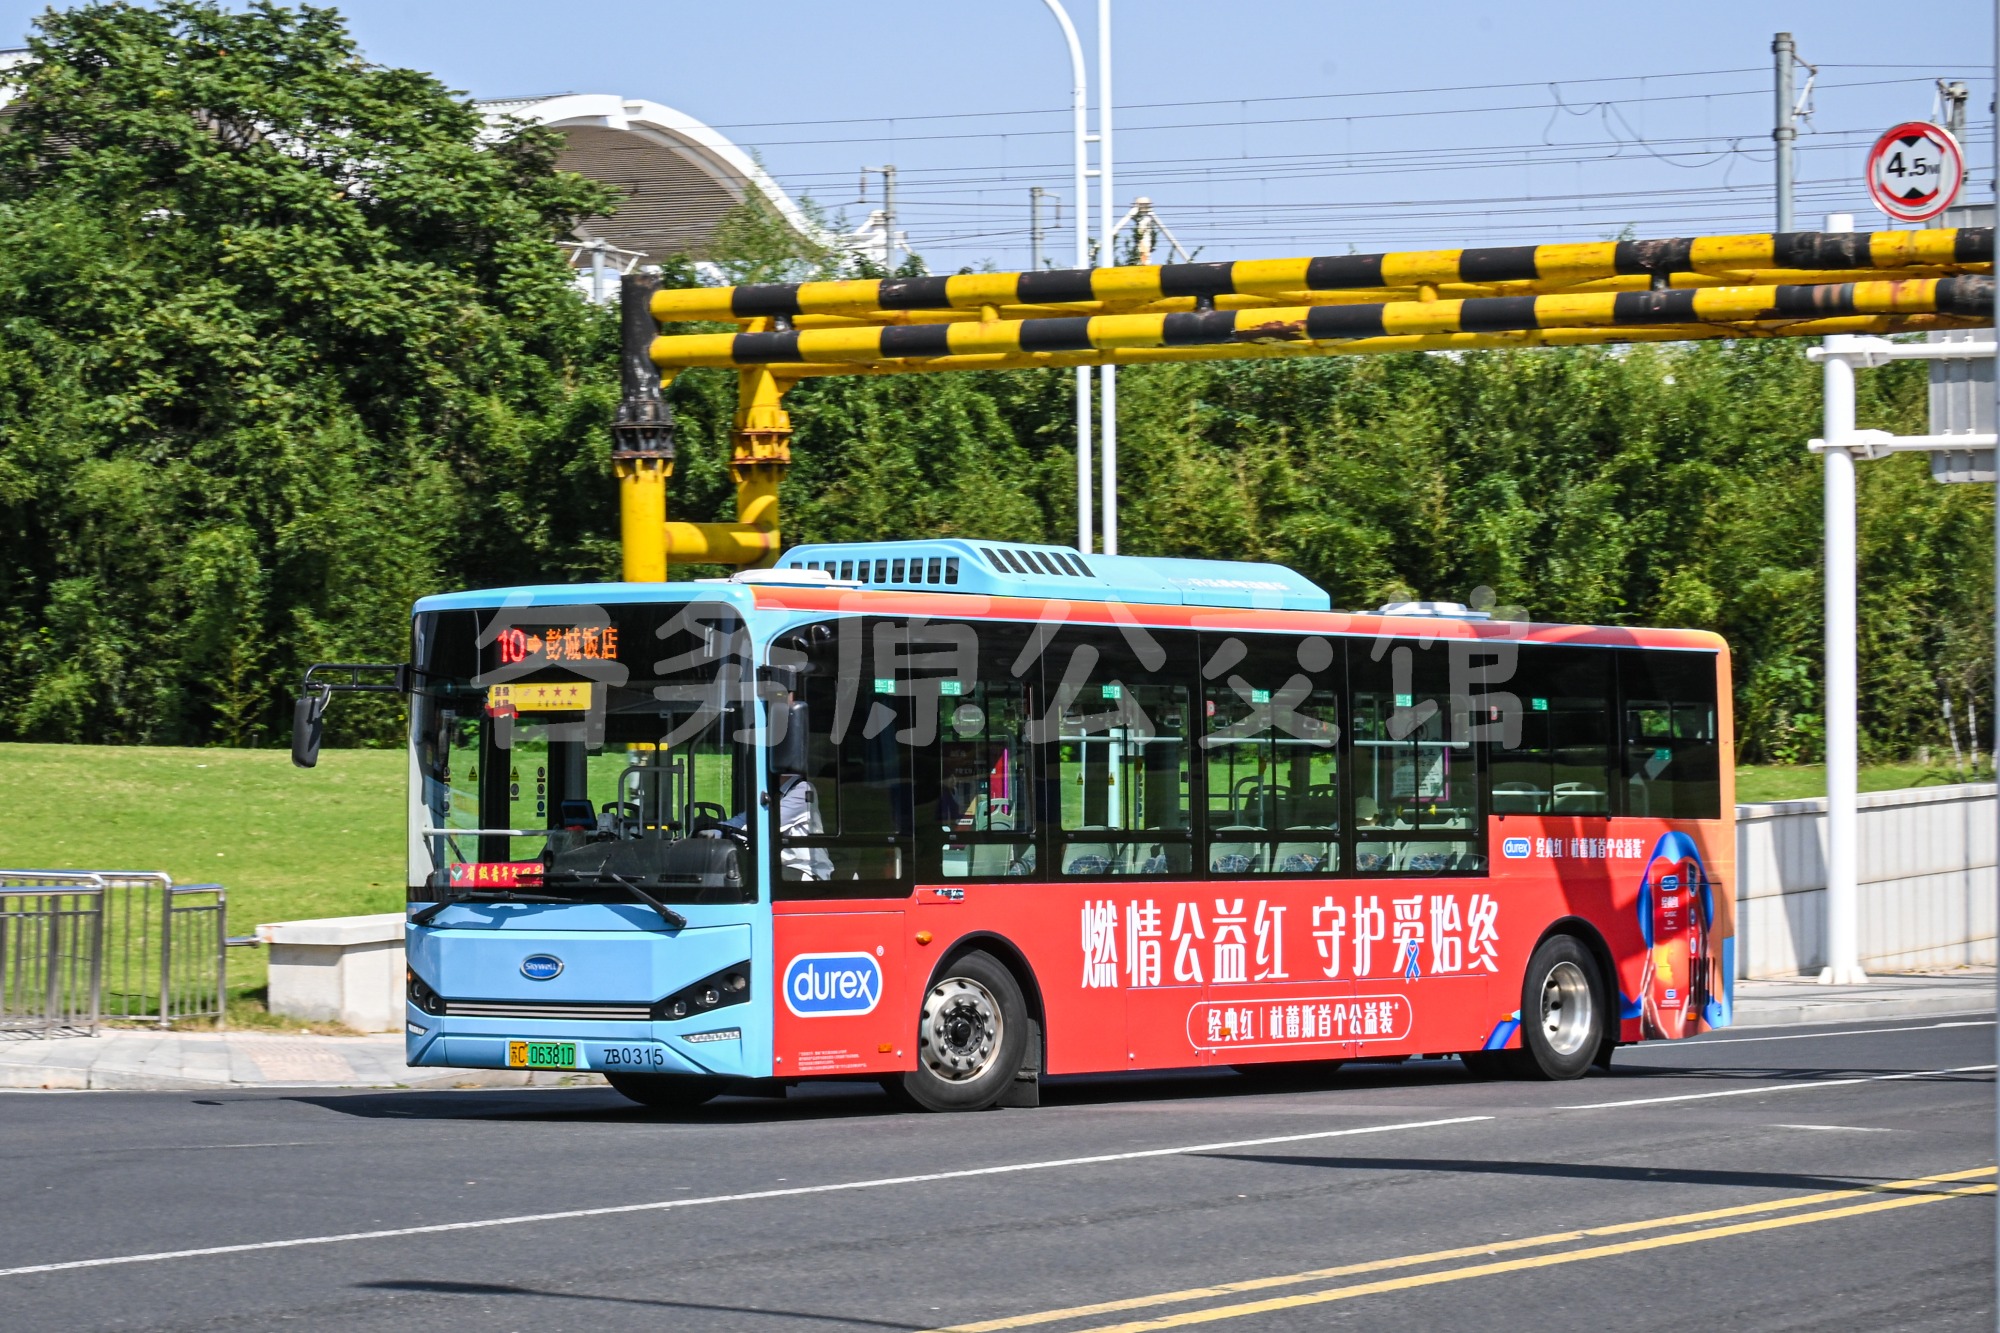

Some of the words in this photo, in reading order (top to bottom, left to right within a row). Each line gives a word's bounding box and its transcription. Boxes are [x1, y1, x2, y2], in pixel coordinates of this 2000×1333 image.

[497, 629, 526, 663] 10
[545, 626, 618, 660] 彭城饭店
[1506, 840, 1528, 853] durex
[1536, 837, 1563, 858] 经典红
[1081, 898, 1289, 989] 燃情公益红
[1312, 894, 1499, 982] 守护爱始终
[794, 963, 875, 1007] durex
[1207, 1007, 1254, 1042] 经典红
[603, 1048, 664, 1066] ZB0315
